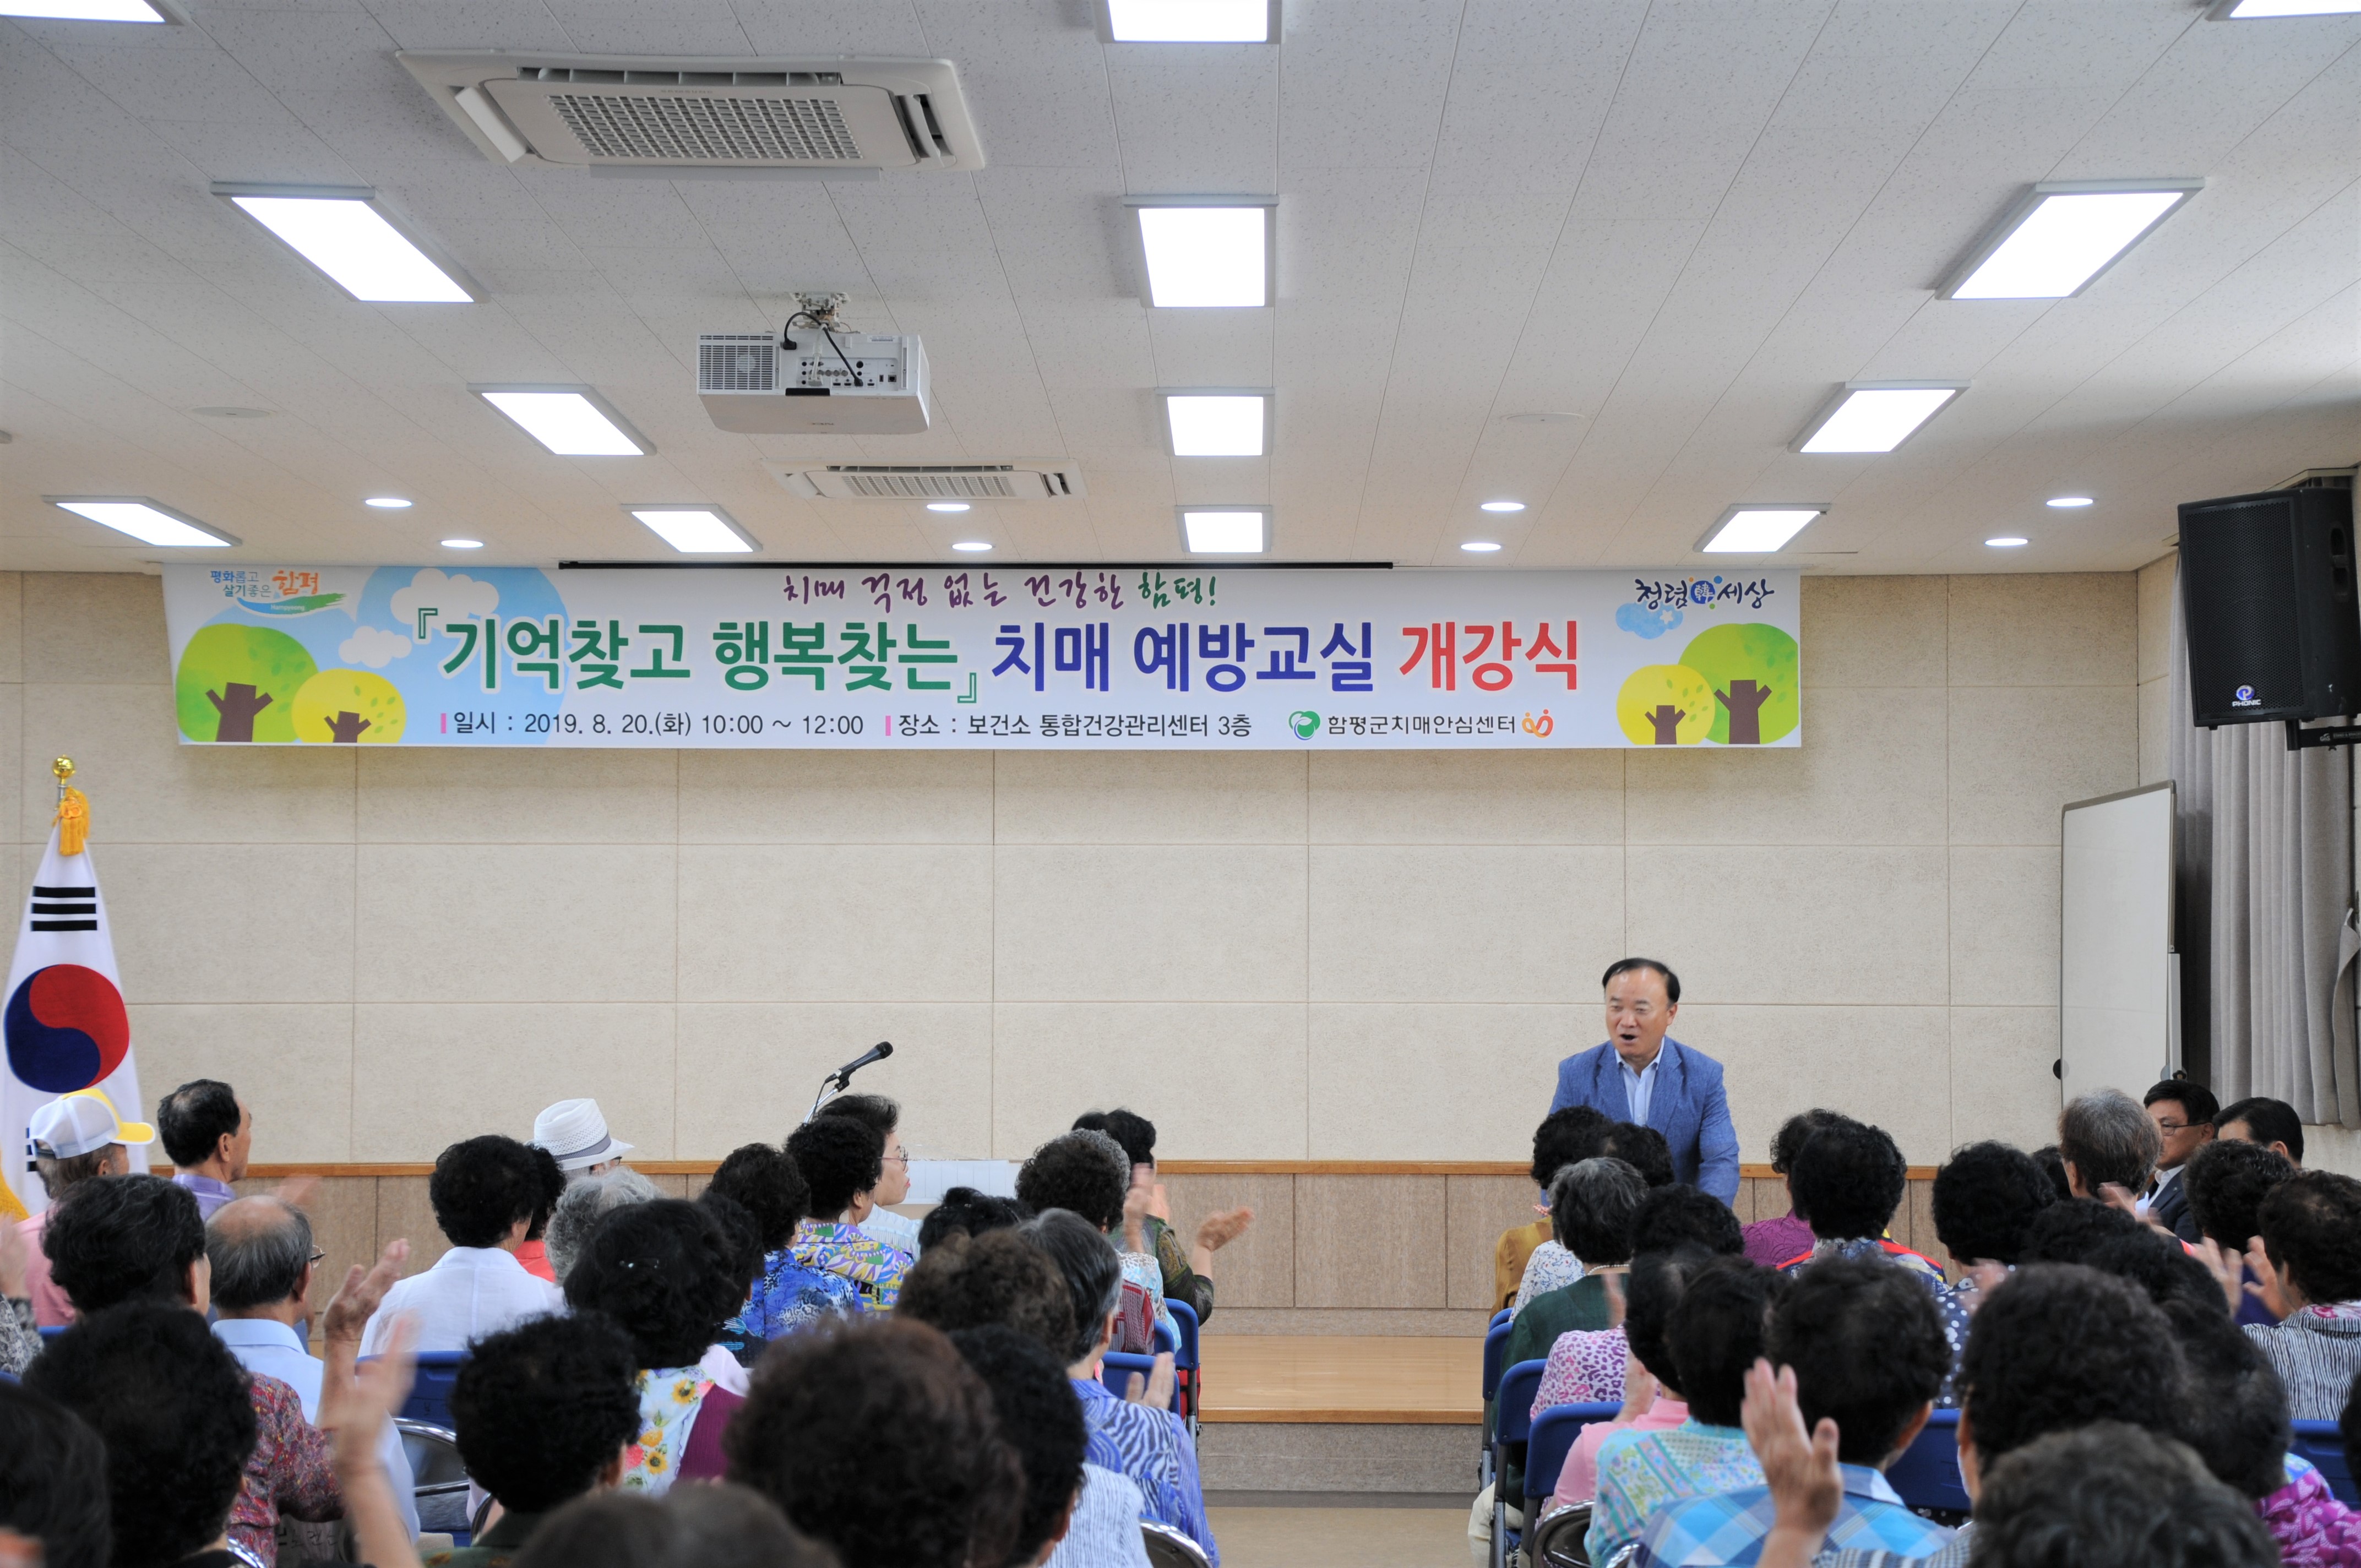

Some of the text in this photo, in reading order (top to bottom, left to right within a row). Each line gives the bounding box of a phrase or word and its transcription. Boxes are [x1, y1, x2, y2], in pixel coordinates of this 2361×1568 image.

[210, 570, 259, 584] 평화롭고
[222, 584, 271, 597] 살기좋은
[783, 575, 845, 605] 치매
[944, 573, 1007, 608] 없는
[1024, 571, 1124, 610] 건강한
[1138, 570, 1216, 609] 함평!
[992, 622, 1109, 692] 치매
[1134, 622, 1373, 693] 예방교실
[1399, 620, 1577, 692] 개강식
[453, 711, 496, 734] 일시
[525, 714, 583, 735] 2019.
[592, 714, 612, 735] 8.
[622, 712, 692, 737] 20.(화)
[702, 715, 764, 735] 10:00
[803, 715, 864, 735] 12:00
[898, 714, 940, 737] 장소
[967, 714, 1031, 737] 보건소
[1040, 714, 1209, 737] 통합건강관리센터
[1218, 714, 1252, 737] 3층
[1328, 714, 1515, 736] 함평군치매안심센터
